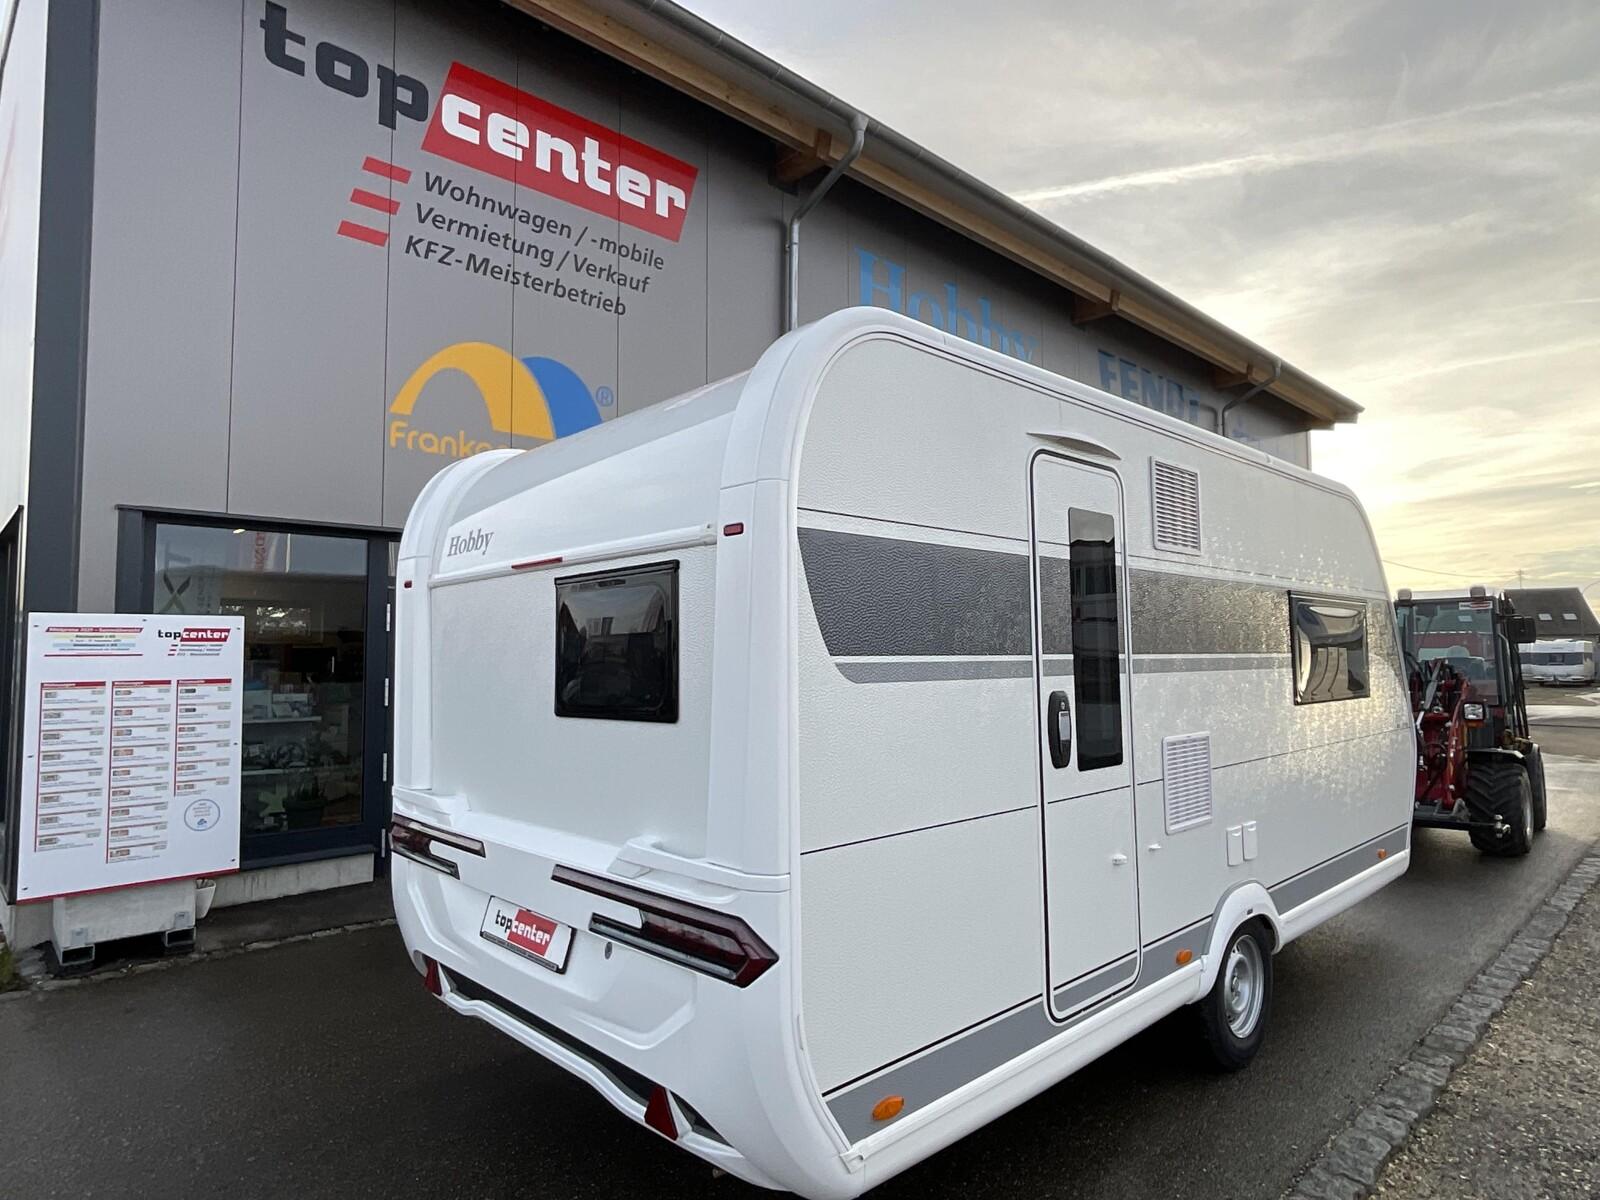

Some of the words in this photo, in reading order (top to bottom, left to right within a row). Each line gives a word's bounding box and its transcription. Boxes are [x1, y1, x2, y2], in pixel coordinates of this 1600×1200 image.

[425, 171, 571, 238] Wohnwagen
[405, 235, 626, 316] KFZ-Meisterbetrieb
[416, 202, 554, 268] Vermietung
[573, 253, 650, 293] Verkauf
[389, 420, 509, 458] Frank
[447, 528, 494, 556] Hobby
